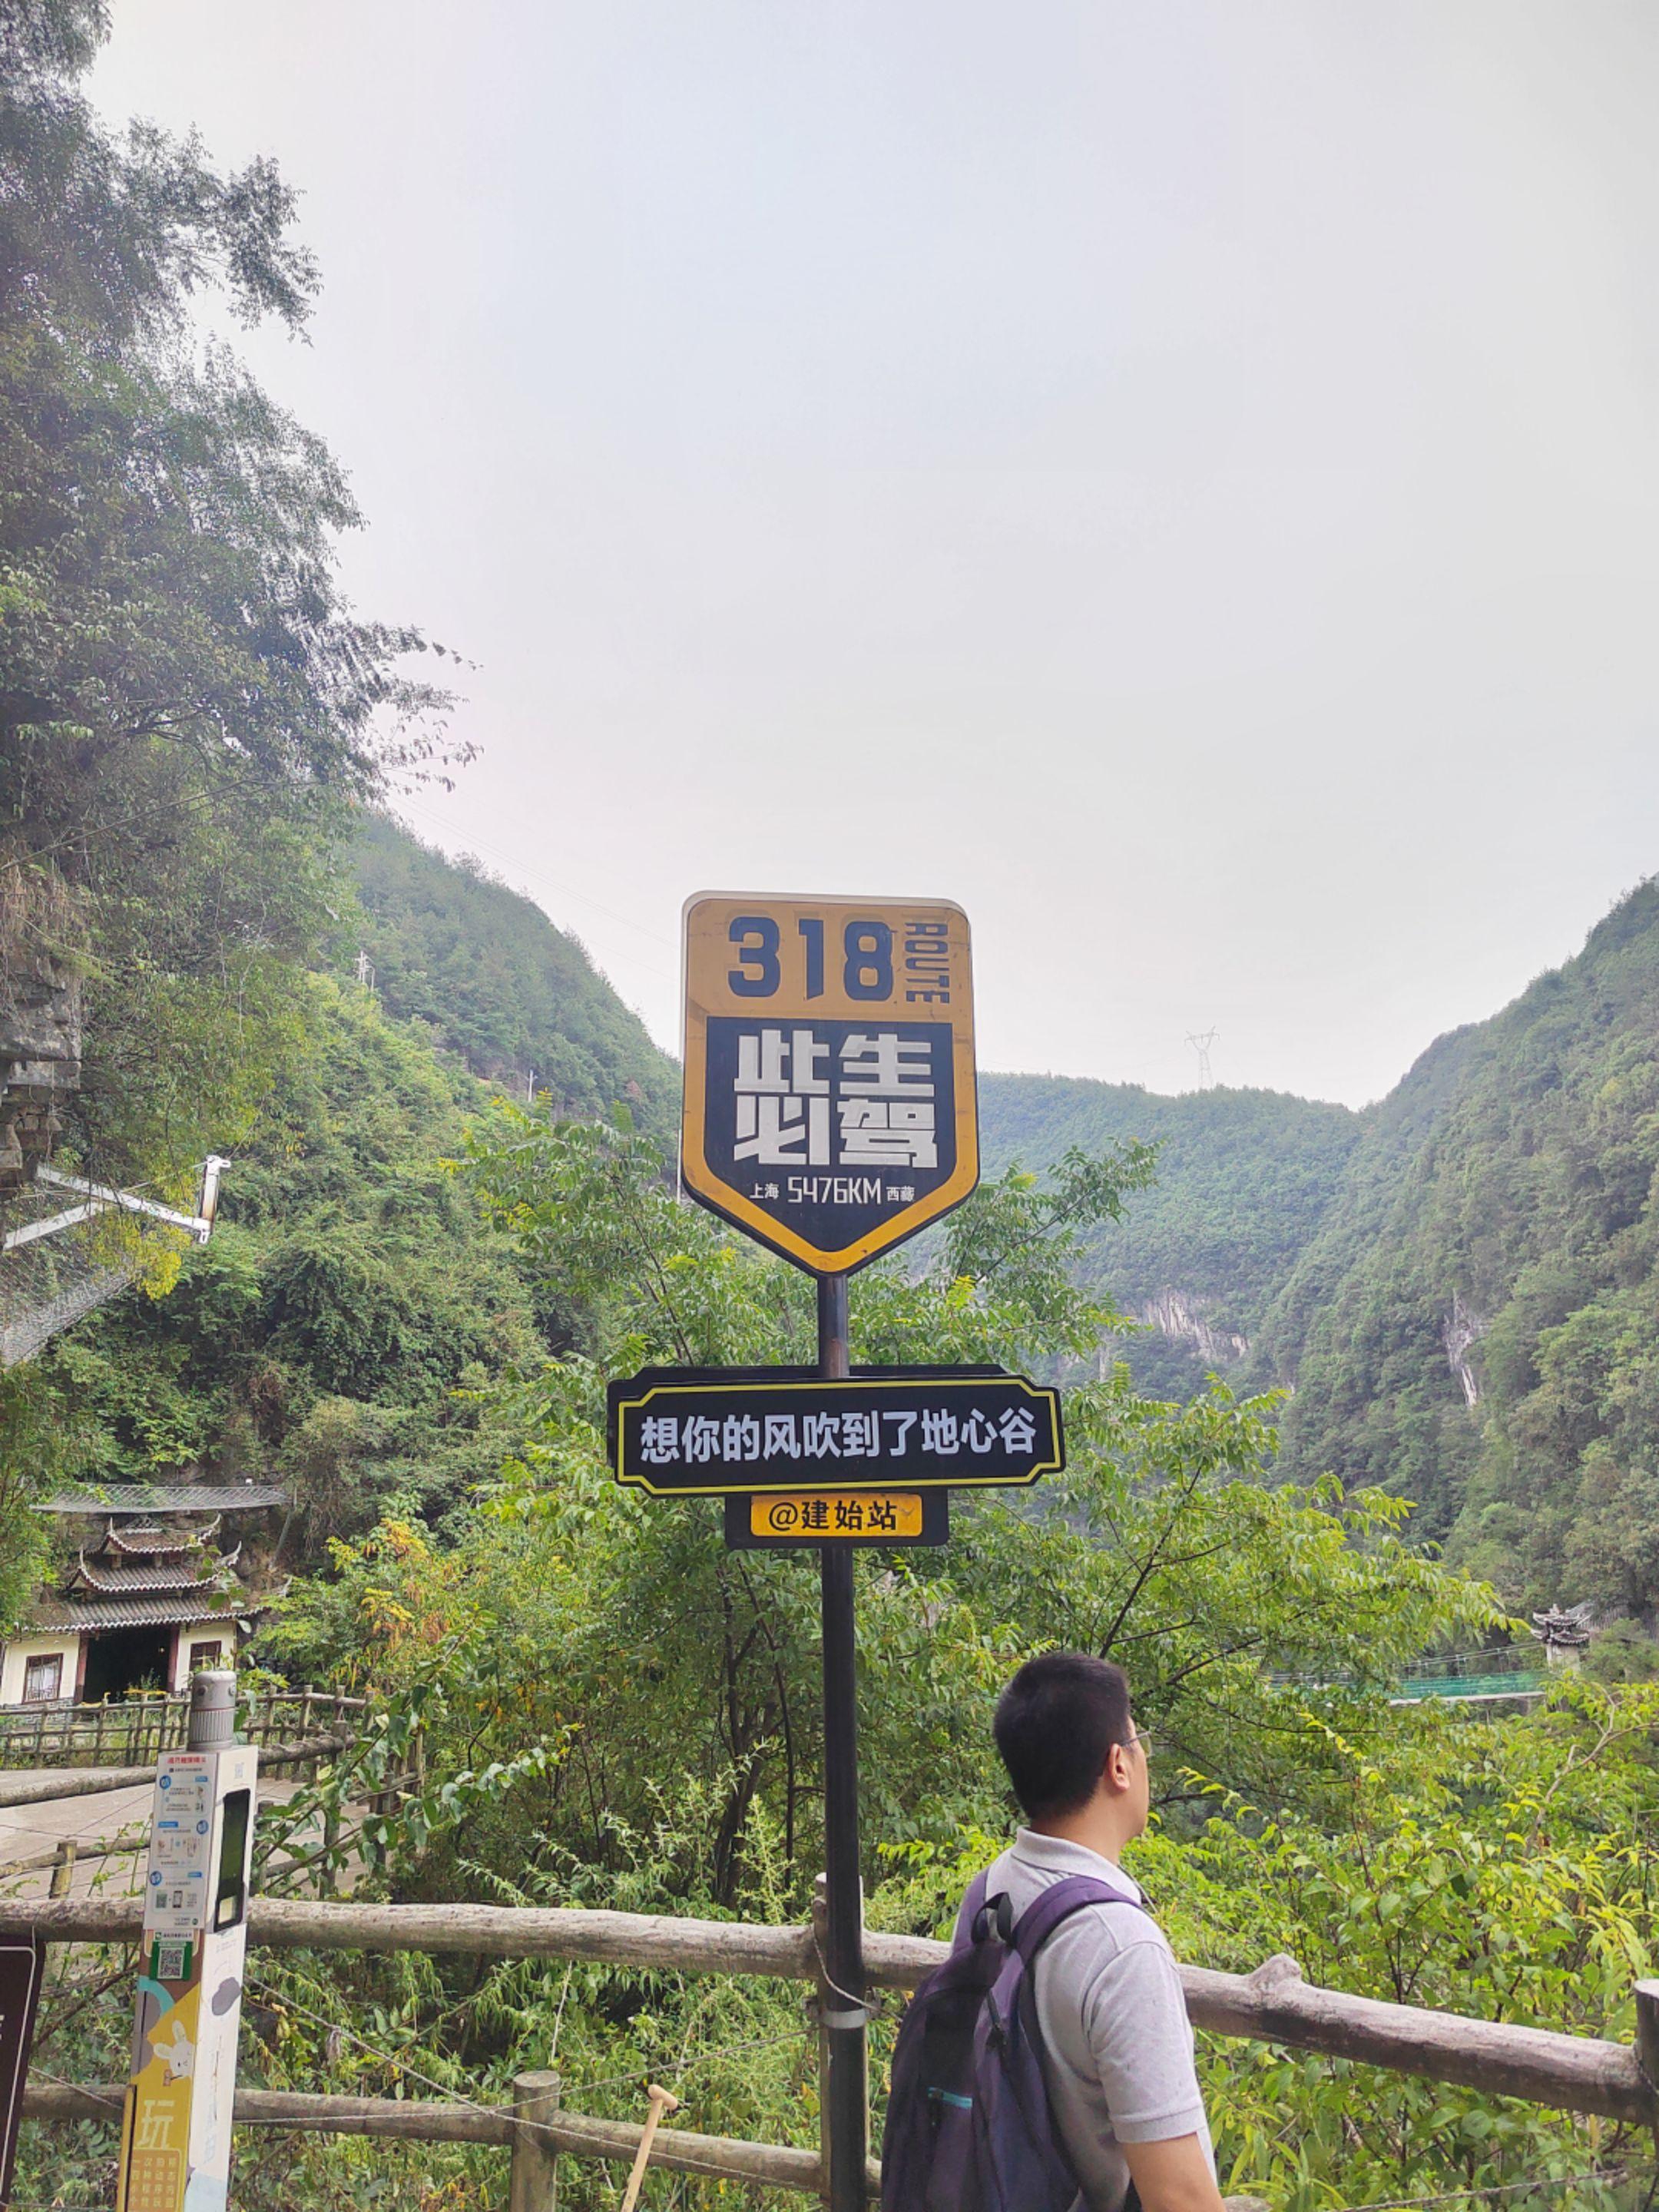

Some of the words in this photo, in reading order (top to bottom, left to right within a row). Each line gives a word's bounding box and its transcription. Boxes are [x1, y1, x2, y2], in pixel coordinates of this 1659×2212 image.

[728, 916, 894, 1002] 318
[905, 922, 950, 1004] ROUTE
[733, 1029, 935, 1097] 此生
[733, 1095, 938, 1168] 必驾
[750, 1182, 779, 1200] 上海
[787, 1177, 882, 1205] 5476KM
[886, 1185, 916, 1202] 西藏
[640, 1407, 1036, 1463] 想你的风吹到了地心谷
[768, 1500, 898, 1532] @建始站
